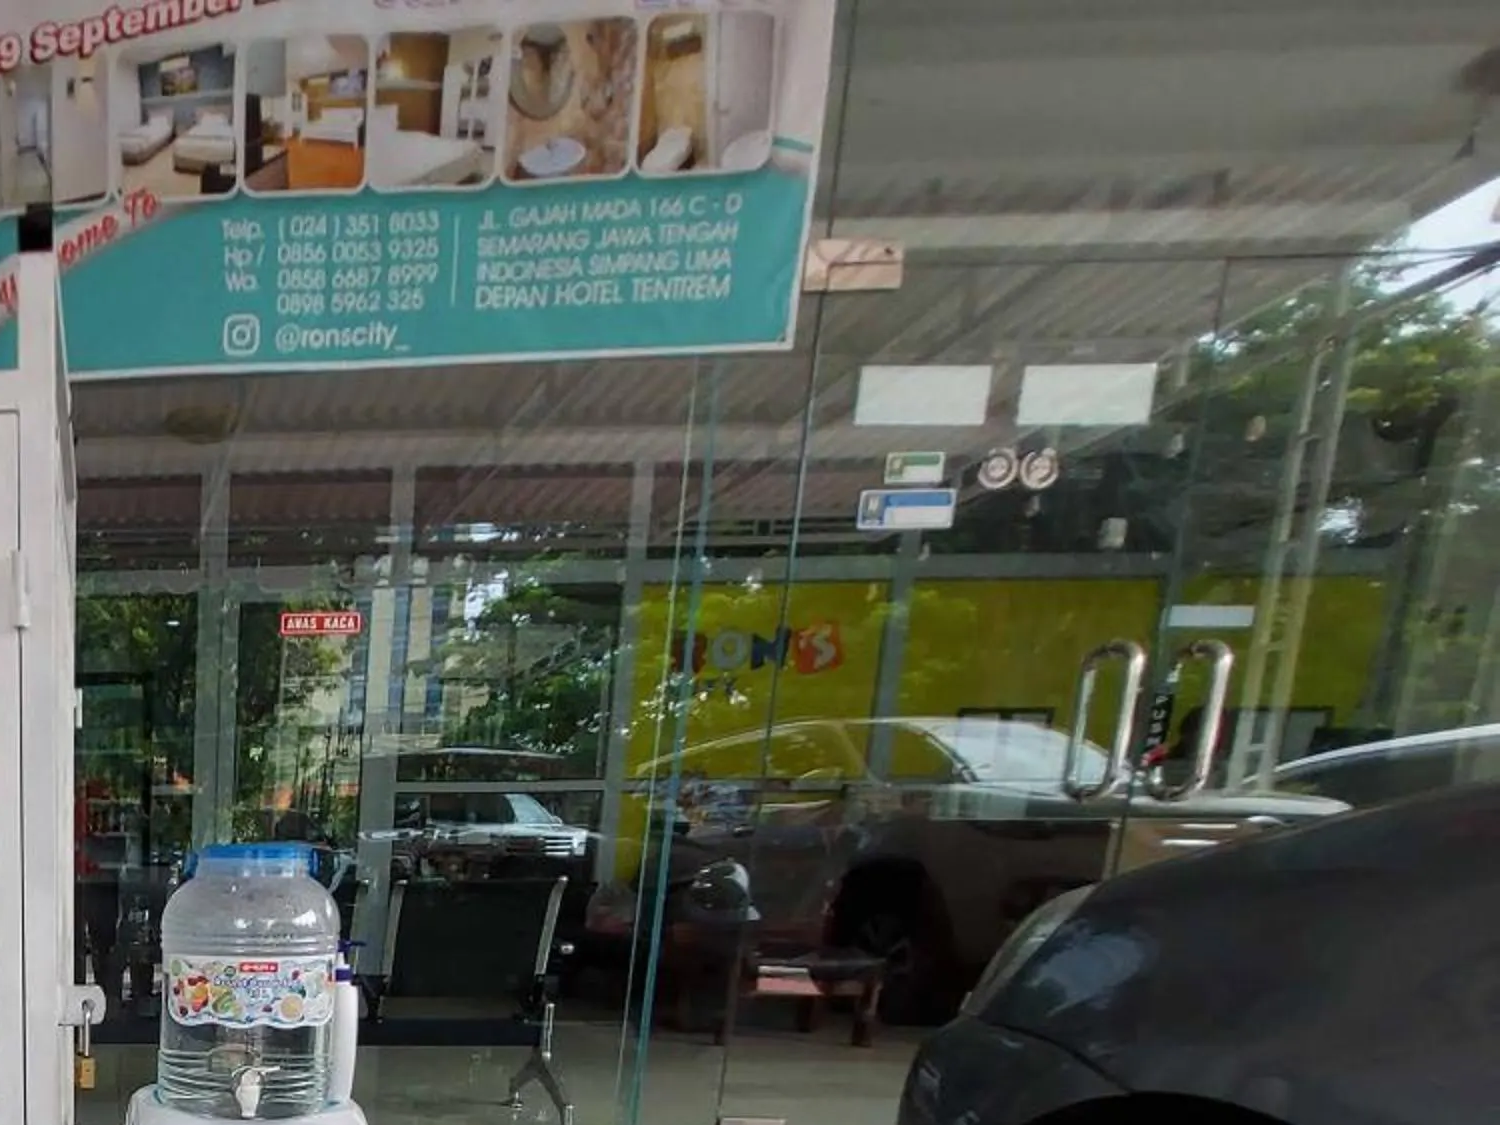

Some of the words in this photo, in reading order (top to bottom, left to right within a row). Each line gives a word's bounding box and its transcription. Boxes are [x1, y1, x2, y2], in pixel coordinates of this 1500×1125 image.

[31, 0, 241, 62] Septemb
[124, 187, 158, 228] To
[508, 201, 578, 228] GAJAH
[582, 197, 642, 223] MADA
[650, 196, 685, 218] 166
[688, 194, 706, 216] C
[724, 192, 744, 215] D
[277, 241, 327, 266] 0856
[332, 239, 382, 264] 0053
[388, 236, 440, 261] 9325
[477, 229, 591, 258] SEMARANG
[595, 225, 653, 251] JAWA
[658, 219, 740, 245] TENGAH
[277, 268, 327, 292] 0858
[332, 265, 382, 289] 6687
[476, 255, 584, 285] INDONESIA
[588, 250, 680, 277] SIMPANG
[685, 246, 733, 272] LIMA
[474, 284, 549, 312] DEPAN
[554, 279, 623, 307] HOTEL
[631, 273, 733, 304] TENTREM
[286, 616, 317, 630] AWAS
[323, 616, 356, 629] KACA
